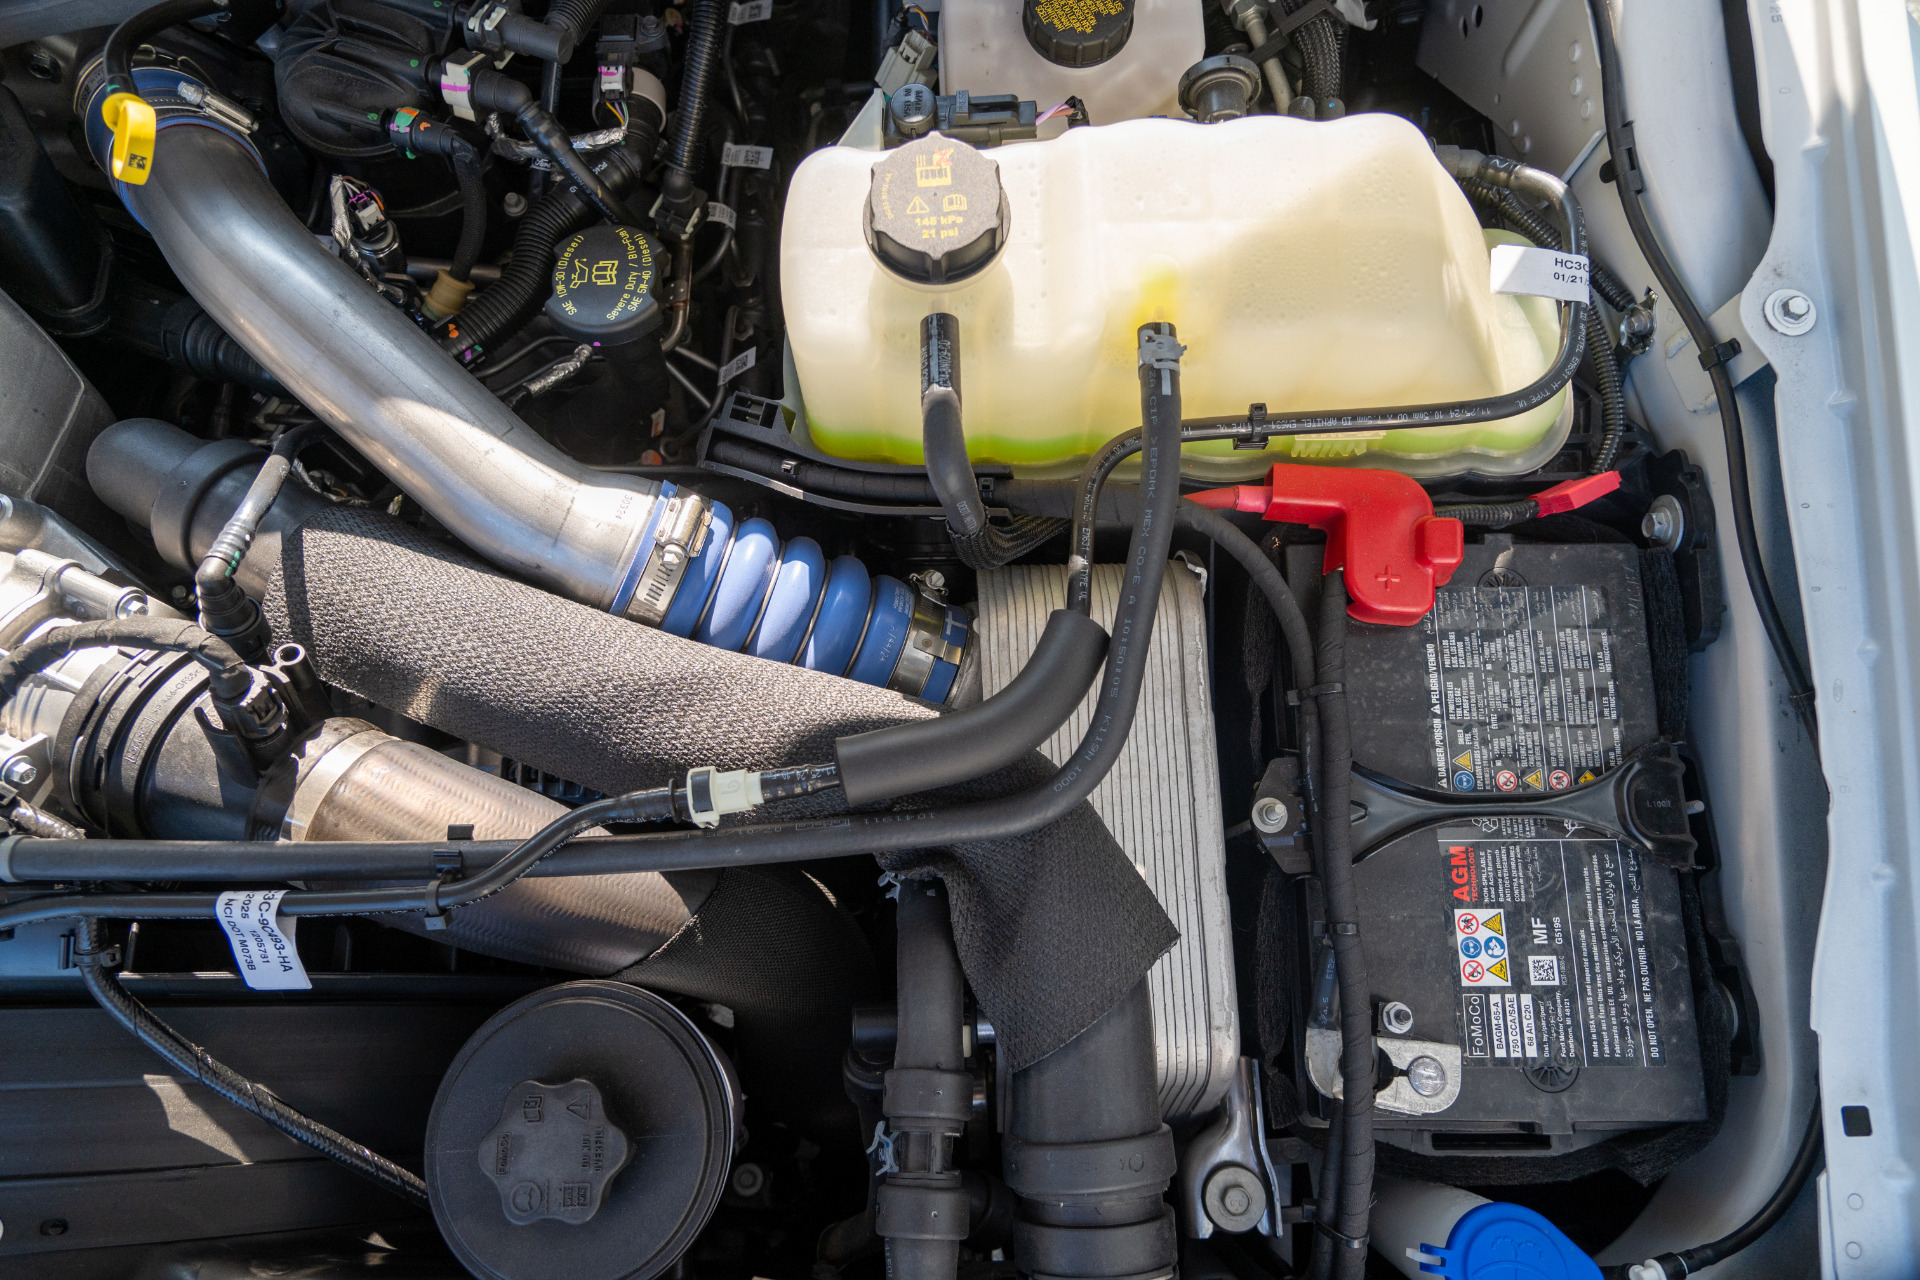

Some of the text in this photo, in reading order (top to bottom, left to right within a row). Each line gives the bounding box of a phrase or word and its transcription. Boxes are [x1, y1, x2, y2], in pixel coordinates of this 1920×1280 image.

[903, 100, 911, 118] USA
[922, 227, 959, 239] 21 psi
[941, 215, 964, 225] kPa
[615, 227, 638, 260] Bio-Fuel
[556, 235, 585, 316] SAE 10W-30 (Diesel)
[625, 271, 641, 290] Duty
[627, 233, 652, 312] SAE 5W-40 (Diesel)
[606, 293, 631, 321] Severe
[1427, 644, 1439, 704] PELIGRO/VENENO
[1434, 718, 1446, 776] DANGER/POISON
[1613, 726, 1621, 764] NSTRUCTIONS.
[1450, 846, 1469, 902] AGM
[1468, 847, 1478, 902] TECHNOLOGY
[1480, 851, 1489, 902] NON-SPILLABLE
[227, 920, 245, 938] DOT
[258, 890, 293, 973] 3C-9C493-HA
[1532, 917, 1547, 944] MF
[1553, 917, 1562, 944] G519S
[1632, 896, 1659, 1057] DO NOT OPEN. NE PAS OUVRIR. NO LA ABRA.
[1508, 997, 1518, 1037] CCA/SAE
[1587, 997, 1593, 1005] US
[1469, 996, 1483, 1055] FoMoCo
[1493, 1002, 1503, 1049] BAGM-65-A
[1526, 1023, 1533, 1034] Ah
[1527, 1037, 1534, 1046] 68
